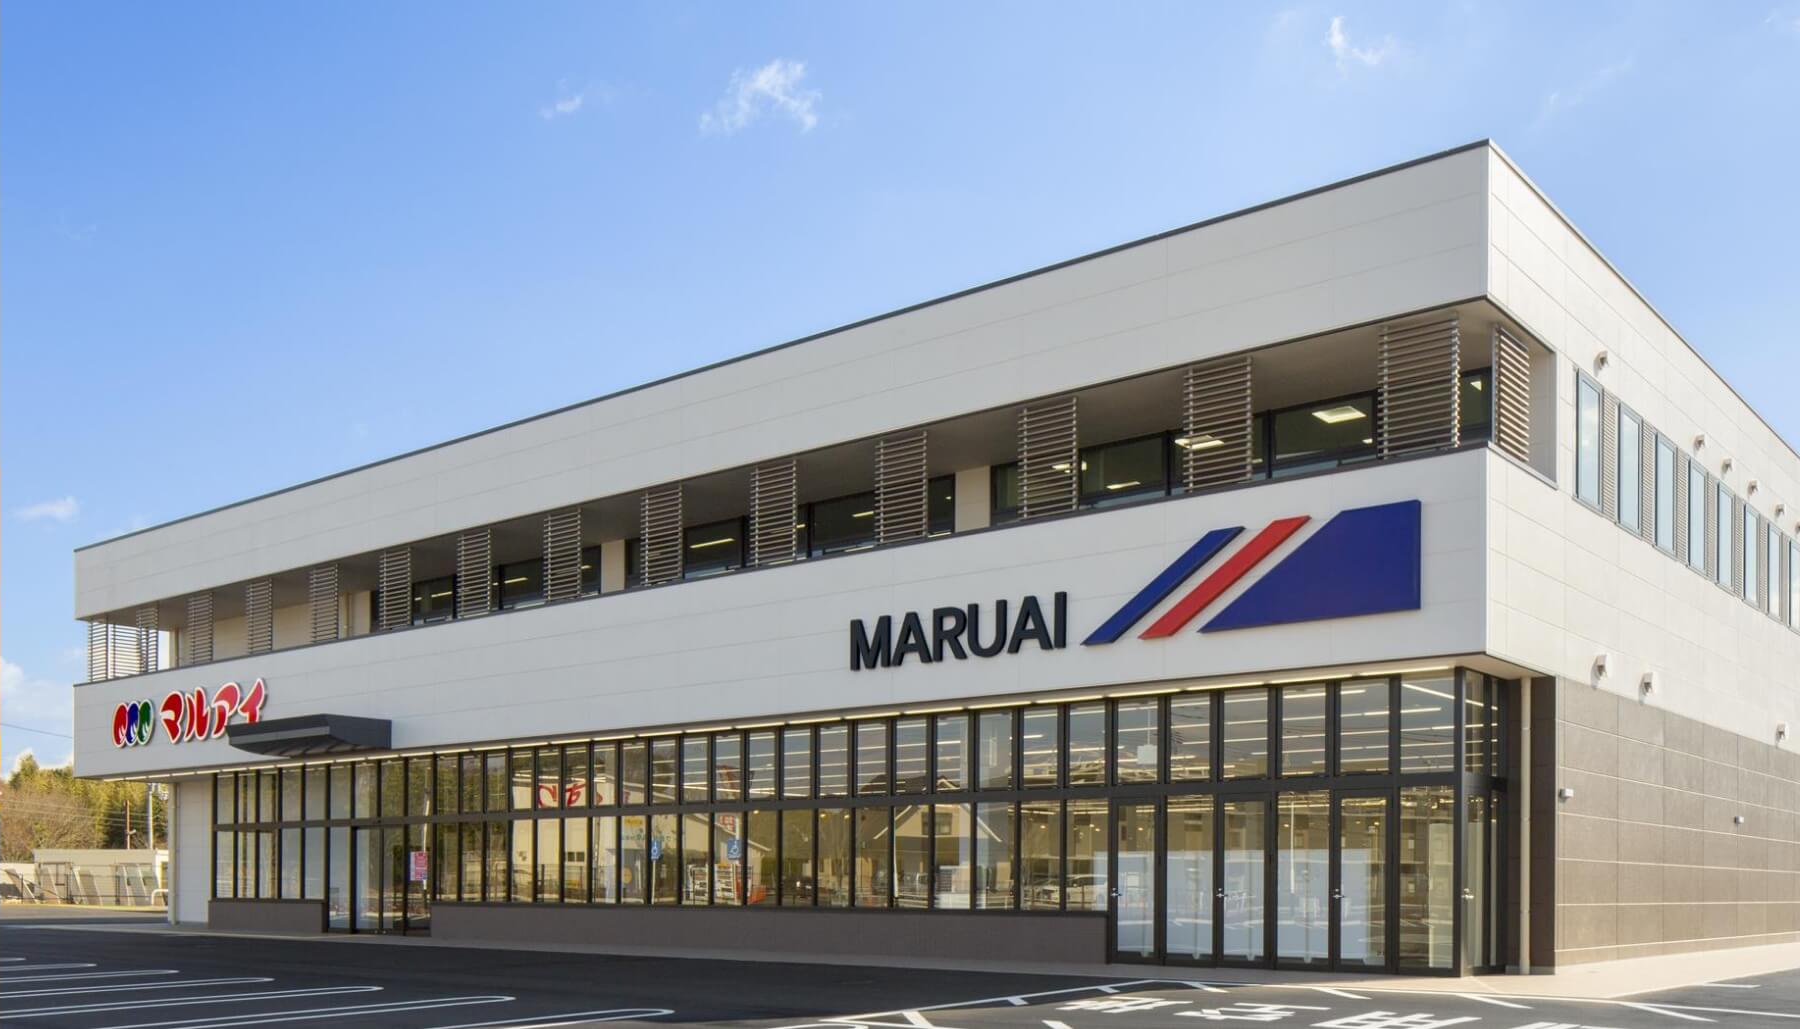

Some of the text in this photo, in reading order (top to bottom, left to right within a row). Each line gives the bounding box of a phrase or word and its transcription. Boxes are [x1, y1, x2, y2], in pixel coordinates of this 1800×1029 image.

[850, 591, 1068, 671] MARUAI
[159, 678, 266, 744] マルアイ
[1055, 996, 1629, 1029] 用空地
